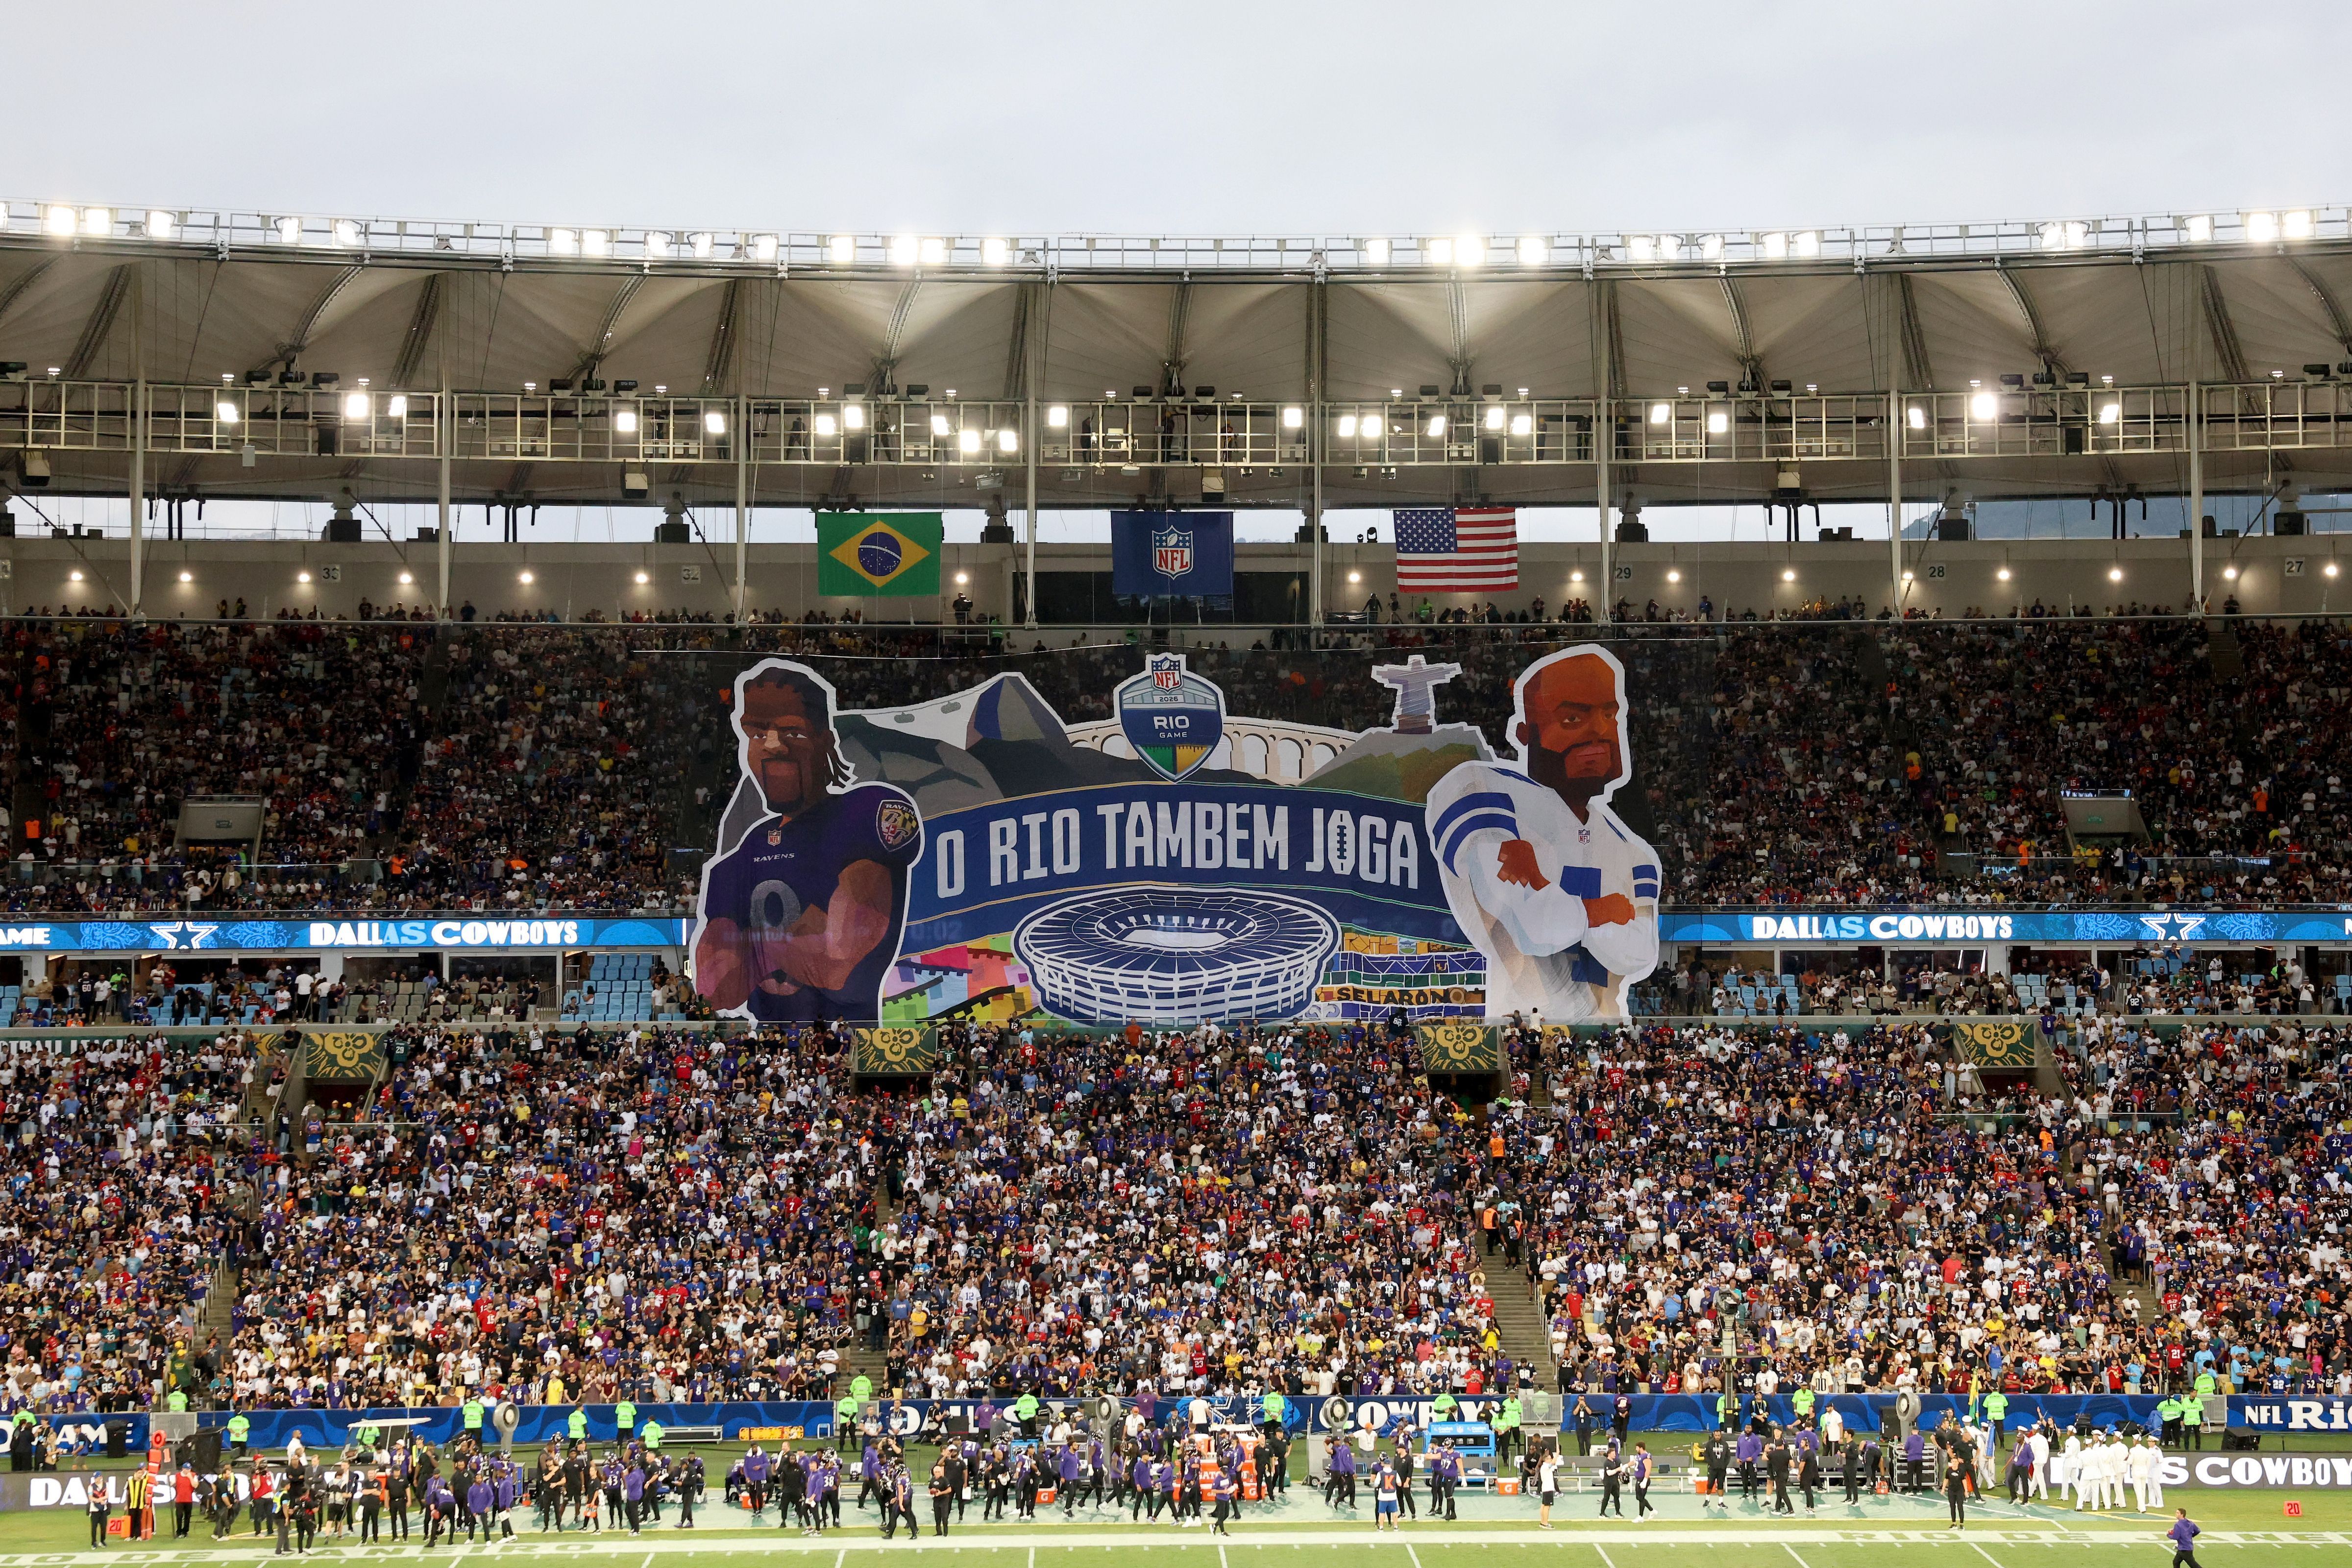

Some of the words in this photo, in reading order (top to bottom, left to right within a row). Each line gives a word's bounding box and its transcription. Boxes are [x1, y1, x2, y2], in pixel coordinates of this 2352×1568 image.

[1156, 549, 1189, 571] NFL
[1929, 566, 1944, 578] 28
[2287, 561, 2303, 572] 27
[1616, 568, 1631, 579] 29
[1154, 672, 1180, 688] NFL
[1153, 715, 1190, 730] RIO
[885, 804, 916, 817] RAVEN
[753, 853, 795, 863] RAVENS
[936, 829, 965, 899] O
[989, 808, 1080, 887] RIO
[1305, 808, 1419, 889] JOGA
[750, 880, 801, 931] 0
[1753, 915, 1863, 939] DALLAS
[1869, 915, 2012, 938] COWBOYS
[310, 921, 427, 946] DALLAS
[431, 921, 578, 945] COWBOYS
[439, 1262, 448, 1271] 21
[872, 1305, 877, 1315] 8
[1360, 1306, 1365, 1316] 9
[2171, 1349, 2180, 1358] 21
[1363, 1376, 1372, 1385] 55
[2274, 1380, 2284, 1389] 22
[334, 1388, 340, 1396] 8
[696, 1387, 701, 1395] 8
[749, 1382, 760, 1392] 88
[1163, 1383, 1170, 1392] 12
[352, 1393, 357, 1402] 8
[516, 1391, 521, 1399] 8
[2245, 1405, 2284, 1424] NFL
[2288, 1400, 2352, 1428] Ri
[965, 1441, 976, 1451] 21
[608, 1477, 618, 1486] 43
[824, 1476, 834, 1487] 38
[1385, 1475, 1394, 1489] K
[2287, 1503, 2300, 1515] 20
[109, 1520, 122, 1532] 20
